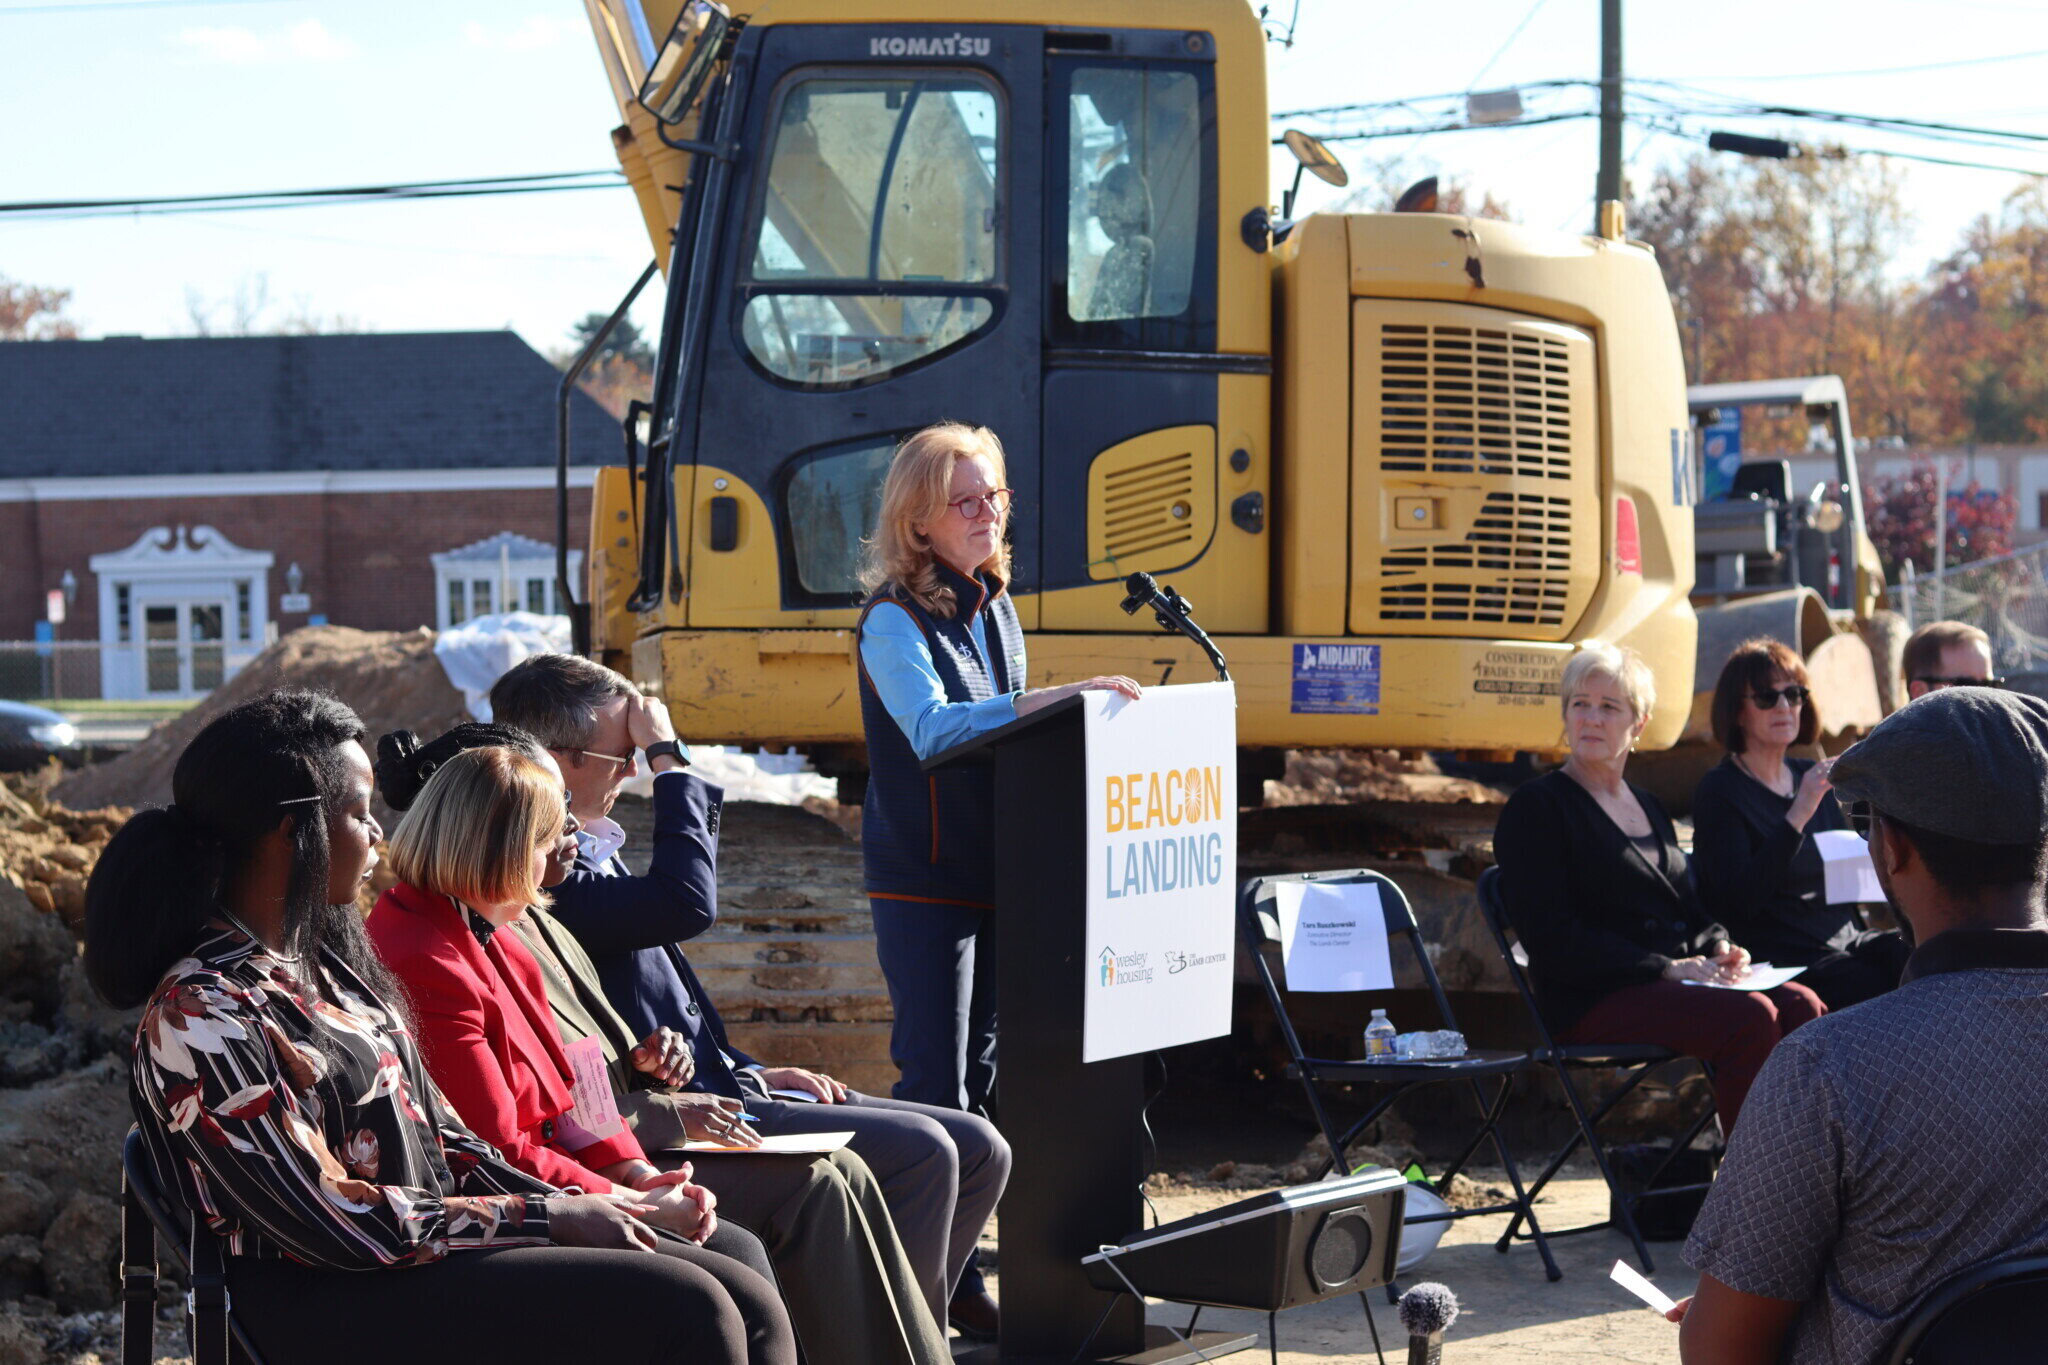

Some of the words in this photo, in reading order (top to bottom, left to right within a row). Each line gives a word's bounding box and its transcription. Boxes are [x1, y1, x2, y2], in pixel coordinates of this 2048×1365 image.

[870, 33, 991, 56] KOMATSU
[1318, 646, 1372, 666] MIDLANTIC
[1485, 651, 1558, 665] CONSTRUCTION
[1106, 766, 1221, 833] BEACON
[1106, 832, 1221, 899] LANDING
[1116, 951, 1148, 968] wesley
[1189, 958, 1205, 967] LAMB
[1205, 953, 1227, 964] CENTER
[1117, 967, 1154, 985] housing
